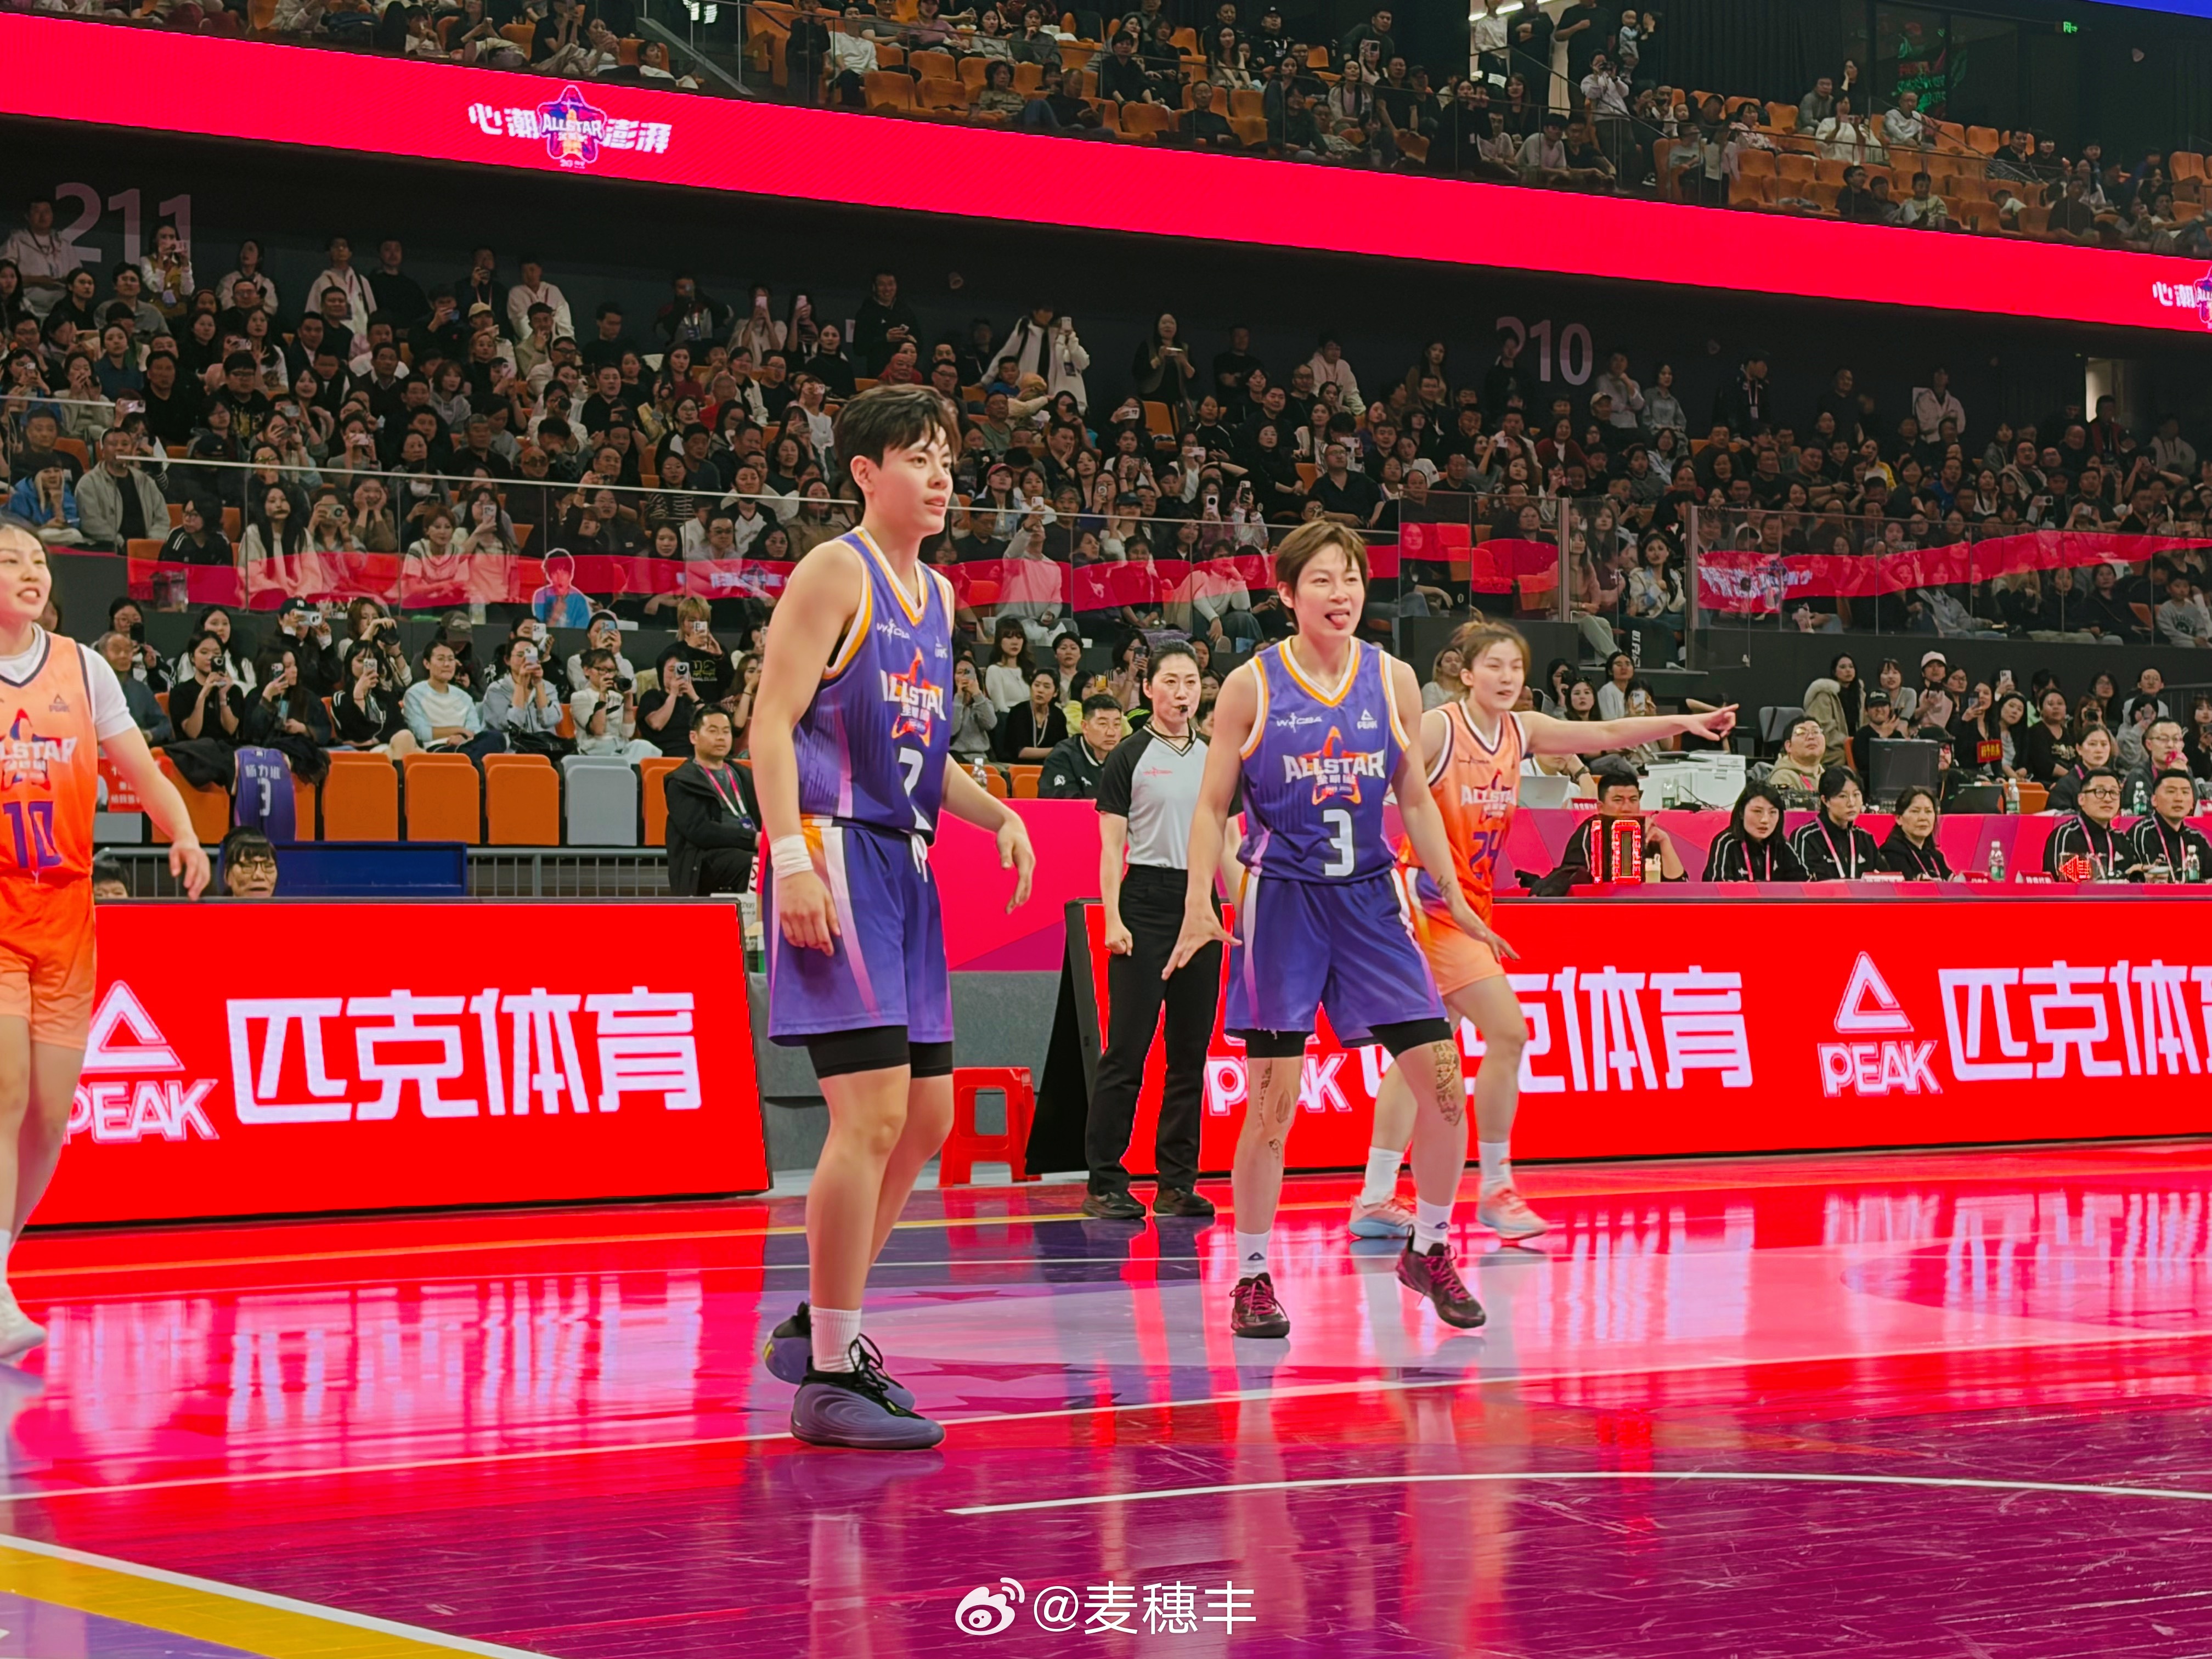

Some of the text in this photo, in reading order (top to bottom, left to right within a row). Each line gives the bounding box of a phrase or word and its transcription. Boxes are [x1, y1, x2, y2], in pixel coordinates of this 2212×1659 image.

[468, 103, 540, 139] 心潮
[542, 113, 603, 139] ALLSTAR
[56, 182, 191, 267] 211
[257, 777, 271, 816] 3
[899, 747, 933, 831] 7
[1282, 749, 1386, 784] ALLSTAR
[3, 801, 63, 869] 10
[1323, 809, 1355, 876] 3
[1469, 829, 1505, 881] 24
[1591, 820, 1641, 884] 10
[226, 986, 702, 1125] 匹克体育
[1818, 1041, 1943, 1097] PEAK
